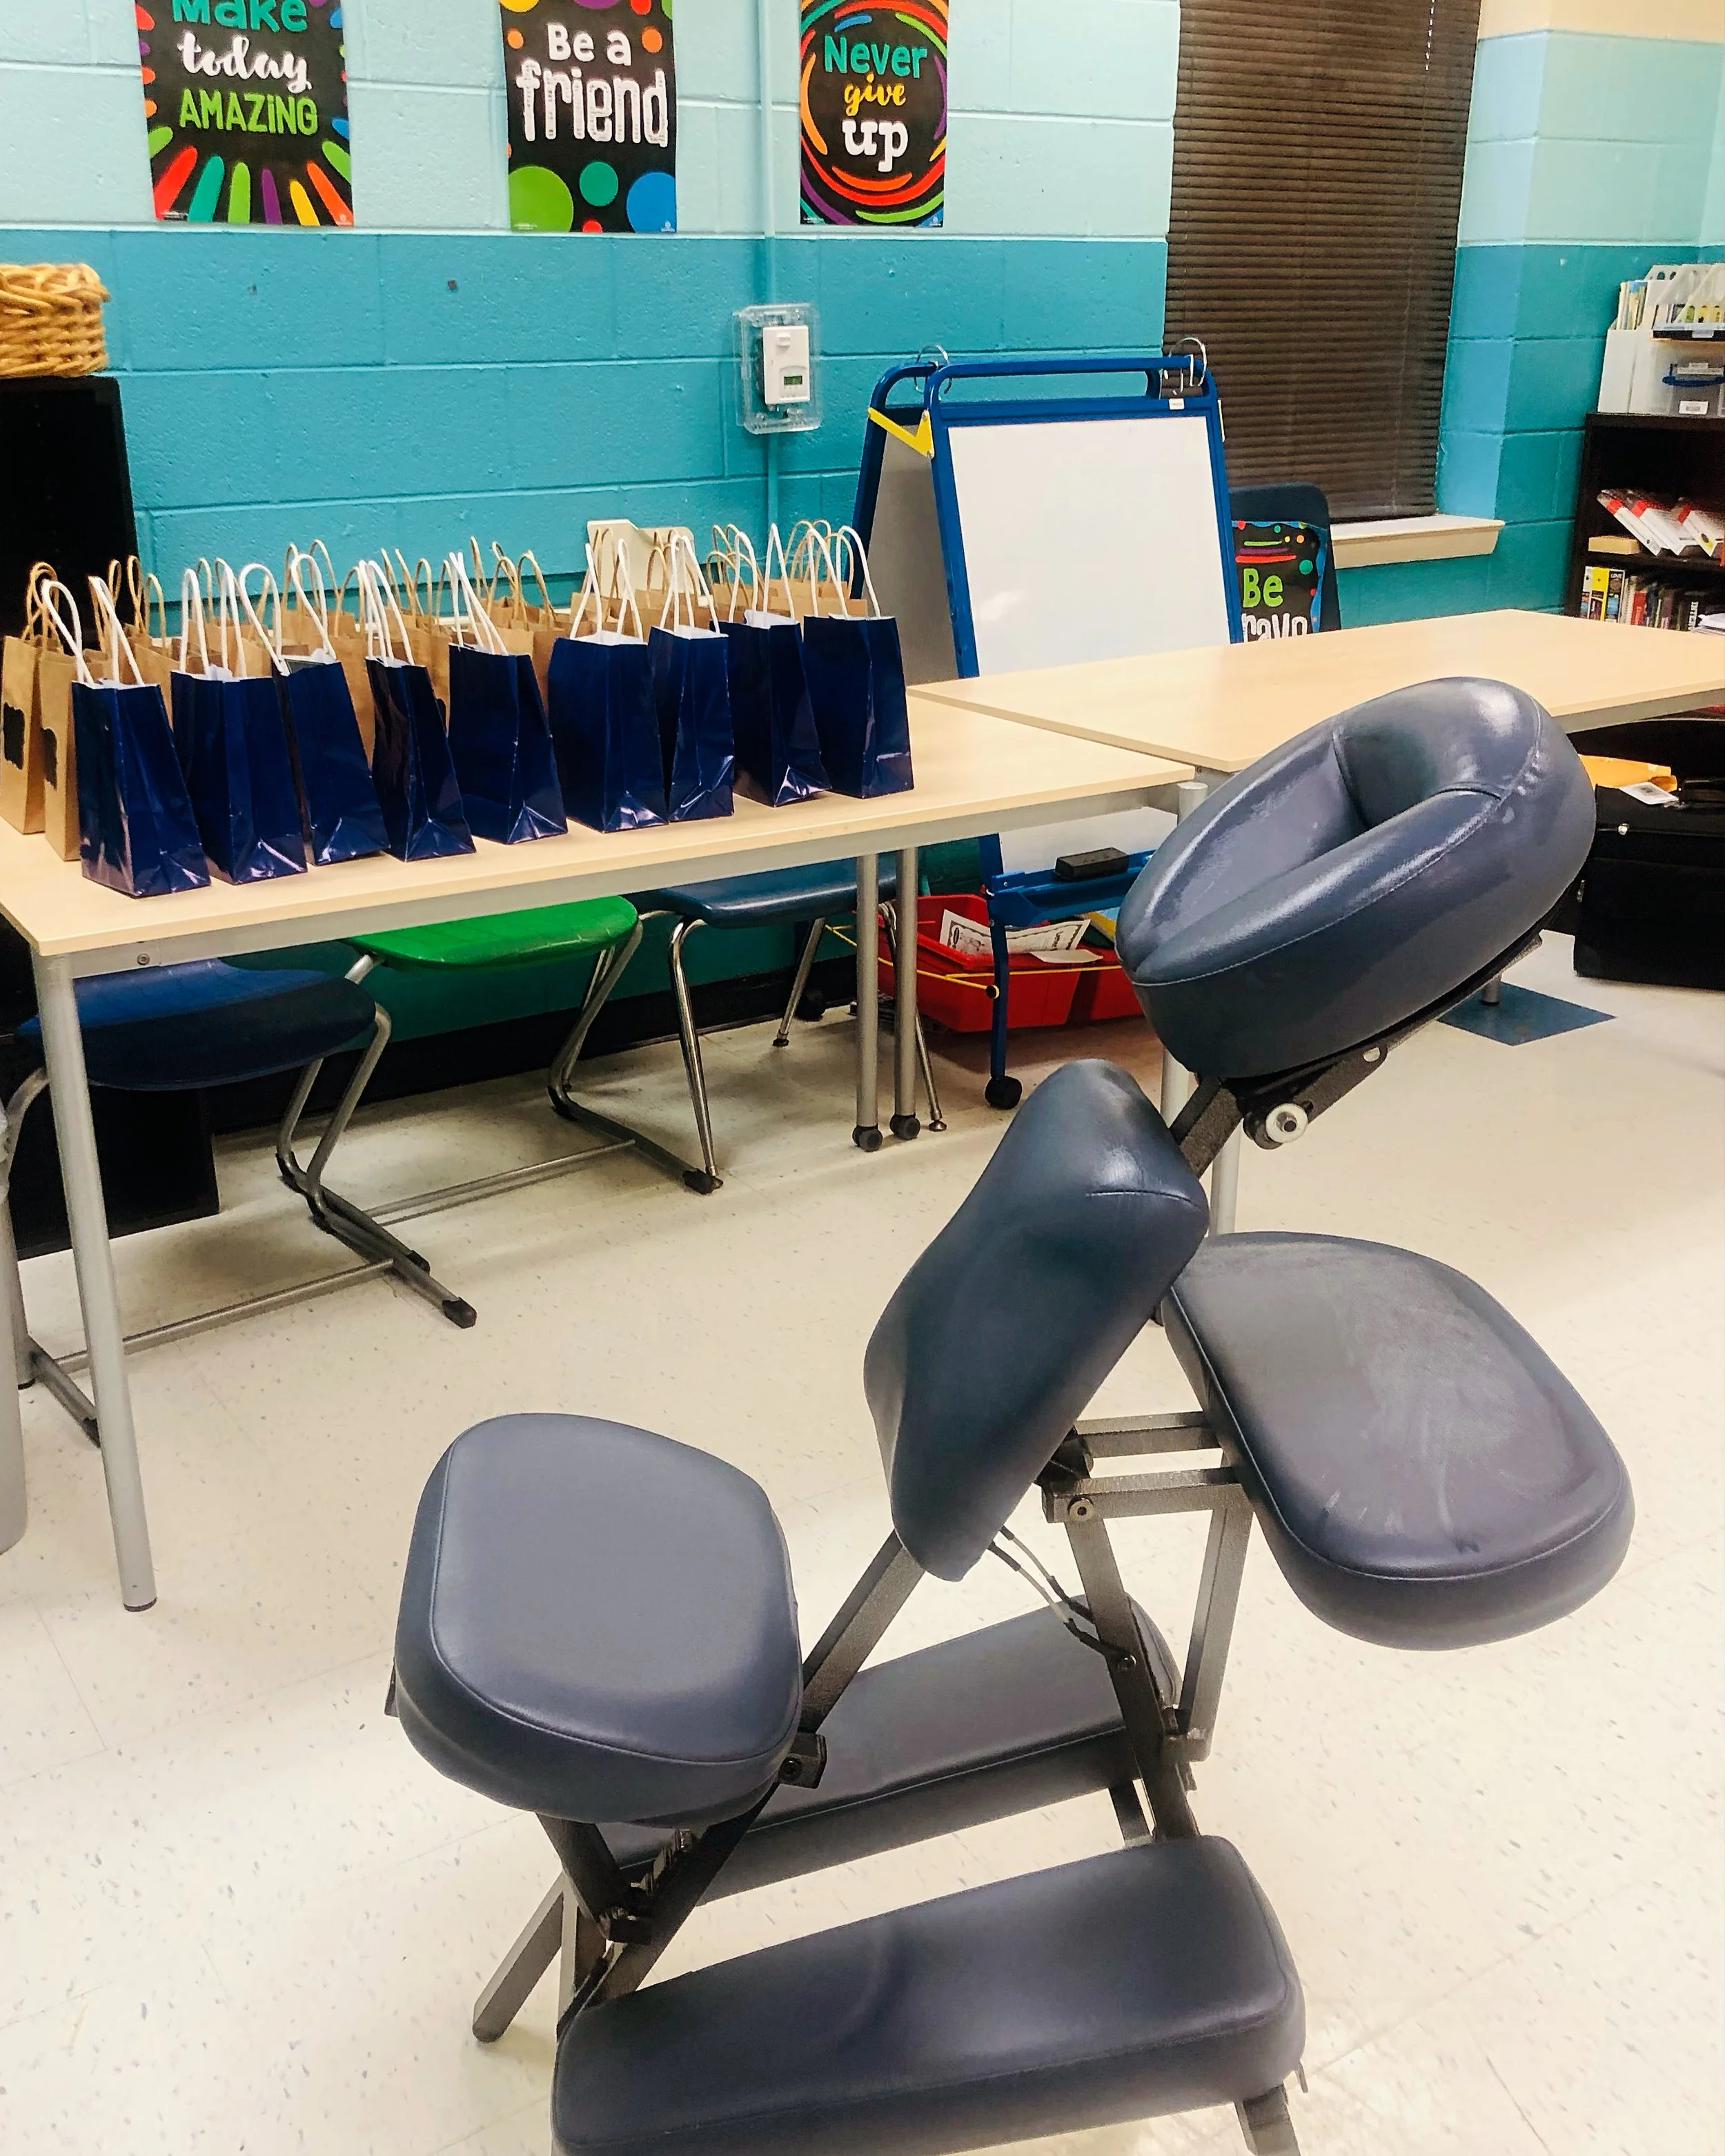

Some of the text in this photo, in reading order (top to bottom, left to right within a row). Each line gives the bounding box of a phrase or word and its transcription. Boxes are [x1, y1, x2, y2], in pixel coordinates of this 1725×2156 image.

[173, 0, 307, 32] Make
[177, 31, 312, 93] today
[547, 23, 631, 66] Be a
[825, 35, 927, 78] Never
[515, 59, 668, 147] friend
[843, 72, 906, 116] give
[842, 120, 909, 172] up
[1243, 567, 1283, 607] Be
[1242, 613, 1308, 643] rav
